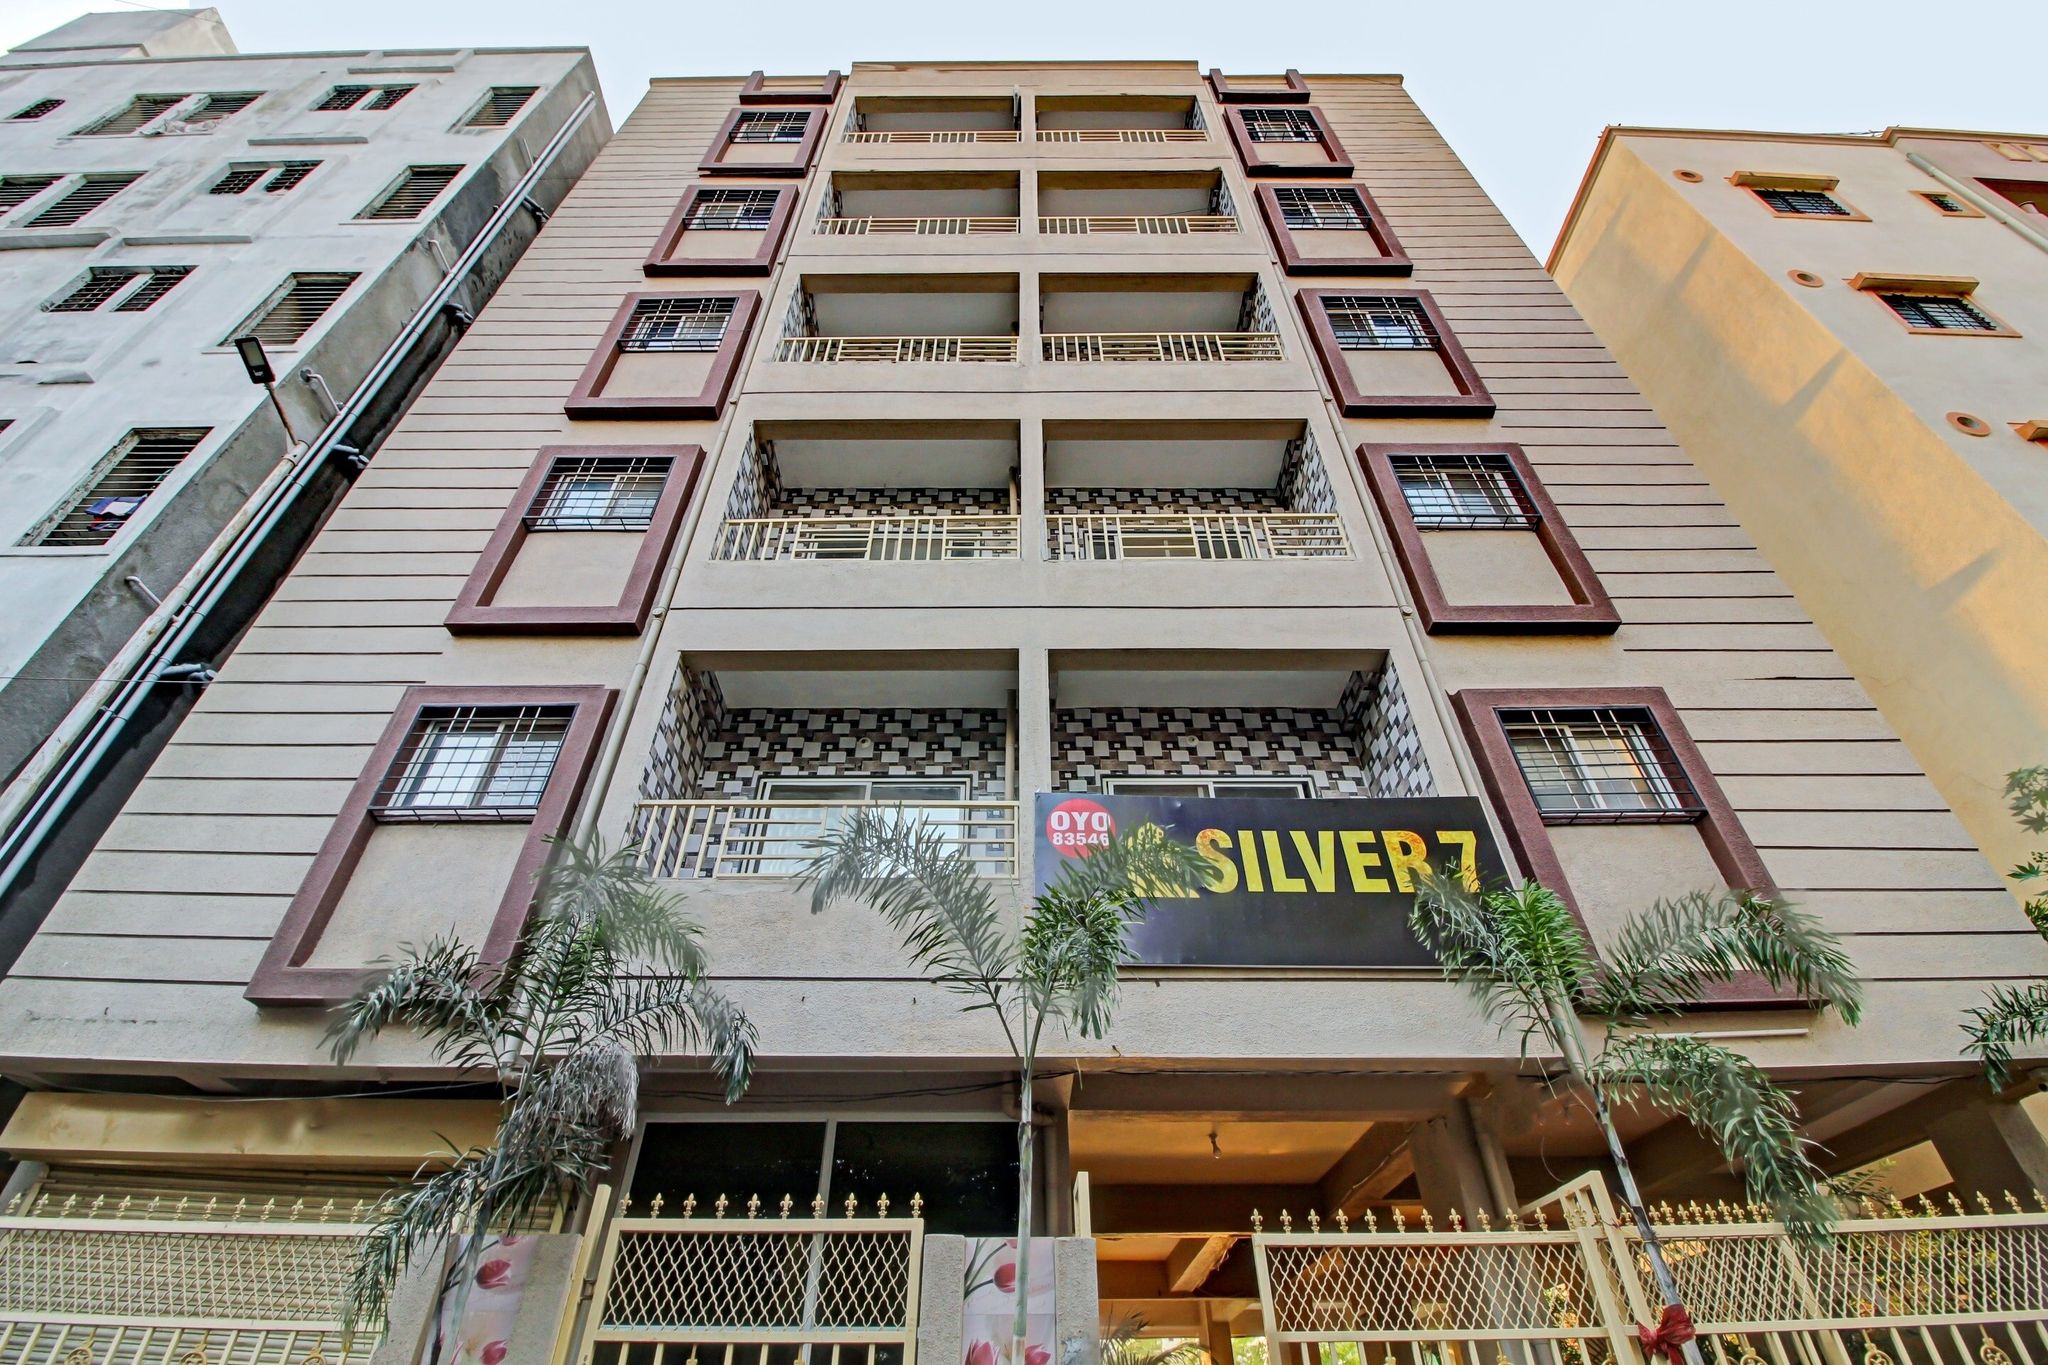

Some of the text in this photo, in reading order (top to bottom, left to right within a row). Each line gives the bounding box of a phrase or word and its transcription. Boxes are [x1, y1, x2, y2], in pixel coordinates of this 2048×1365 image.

[1050, 811, 1111, 831] OYO
[1052, 832, 1110, 846] 83546
[1195, 828, 1481, 893] SILVER 7
